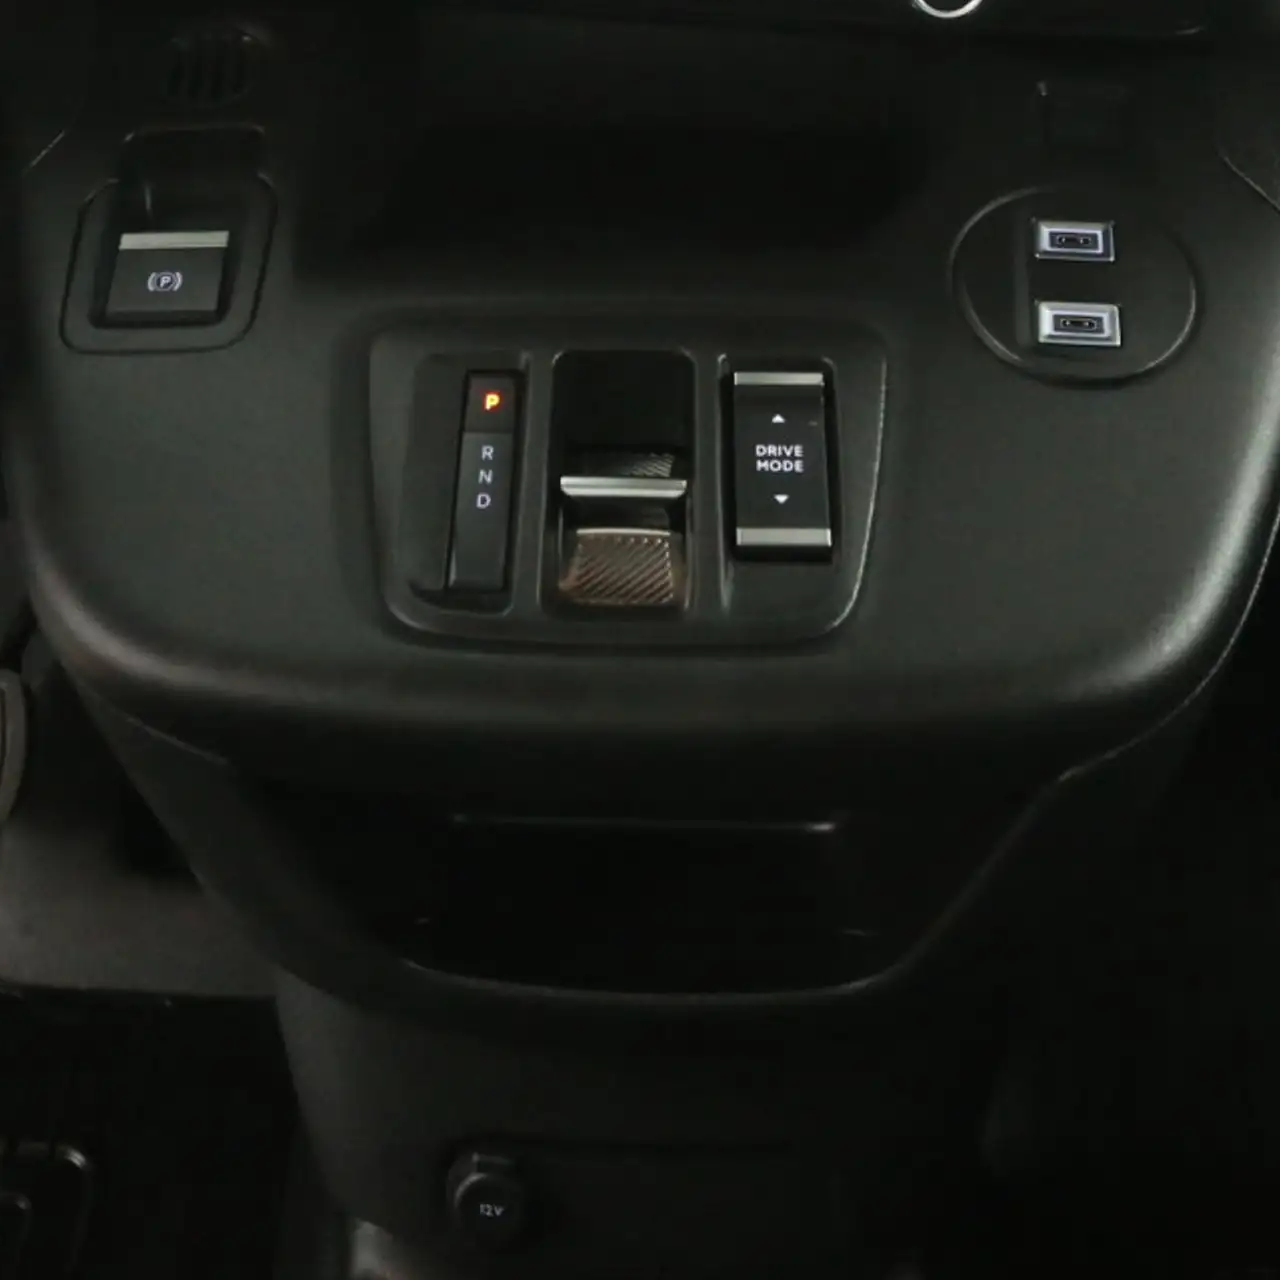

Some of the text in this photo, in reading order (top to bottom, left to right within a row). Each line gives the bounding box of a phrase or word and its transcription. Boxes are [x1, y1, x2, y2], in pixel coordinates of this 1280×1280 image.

[484, 392, 501, 410] P
[481, 445, 494, 461] R
[755, 443, 804, 458] DRIVE
[755, 458, 804, 473] MODE
[478, 468, 493, 485] N
[476, 492, 492, 509] D
